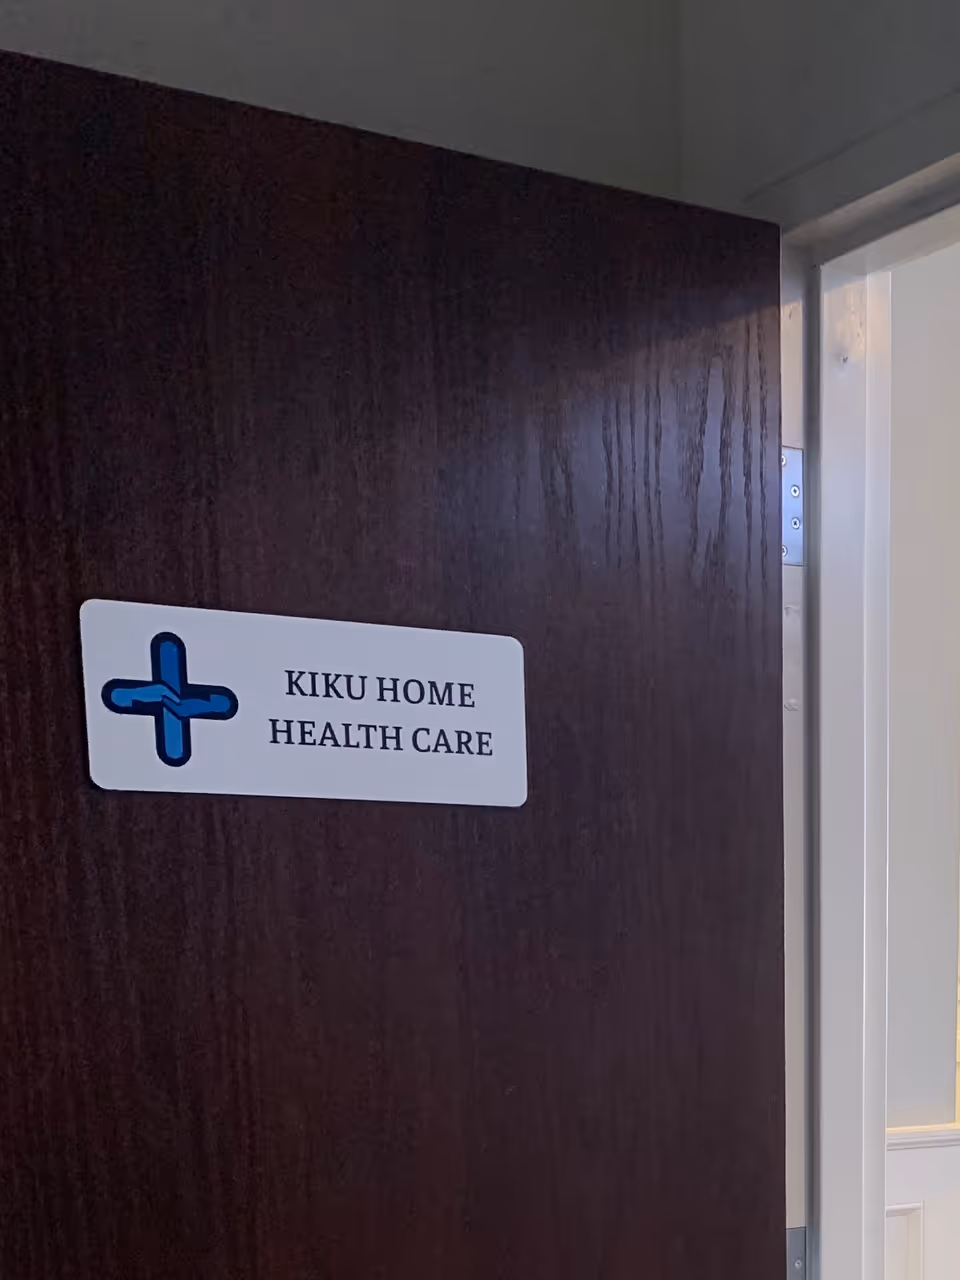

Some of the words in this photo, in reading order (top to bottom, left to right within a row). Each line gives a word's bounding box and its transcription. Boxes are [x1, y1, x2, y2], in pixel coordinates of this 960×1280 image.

[284, 669, 367, 700] KIKU
[376, 676, 476, 708] HOME
[268, 718, 404, 751] HEALTH
[412, 727, 494, 756] CARE
